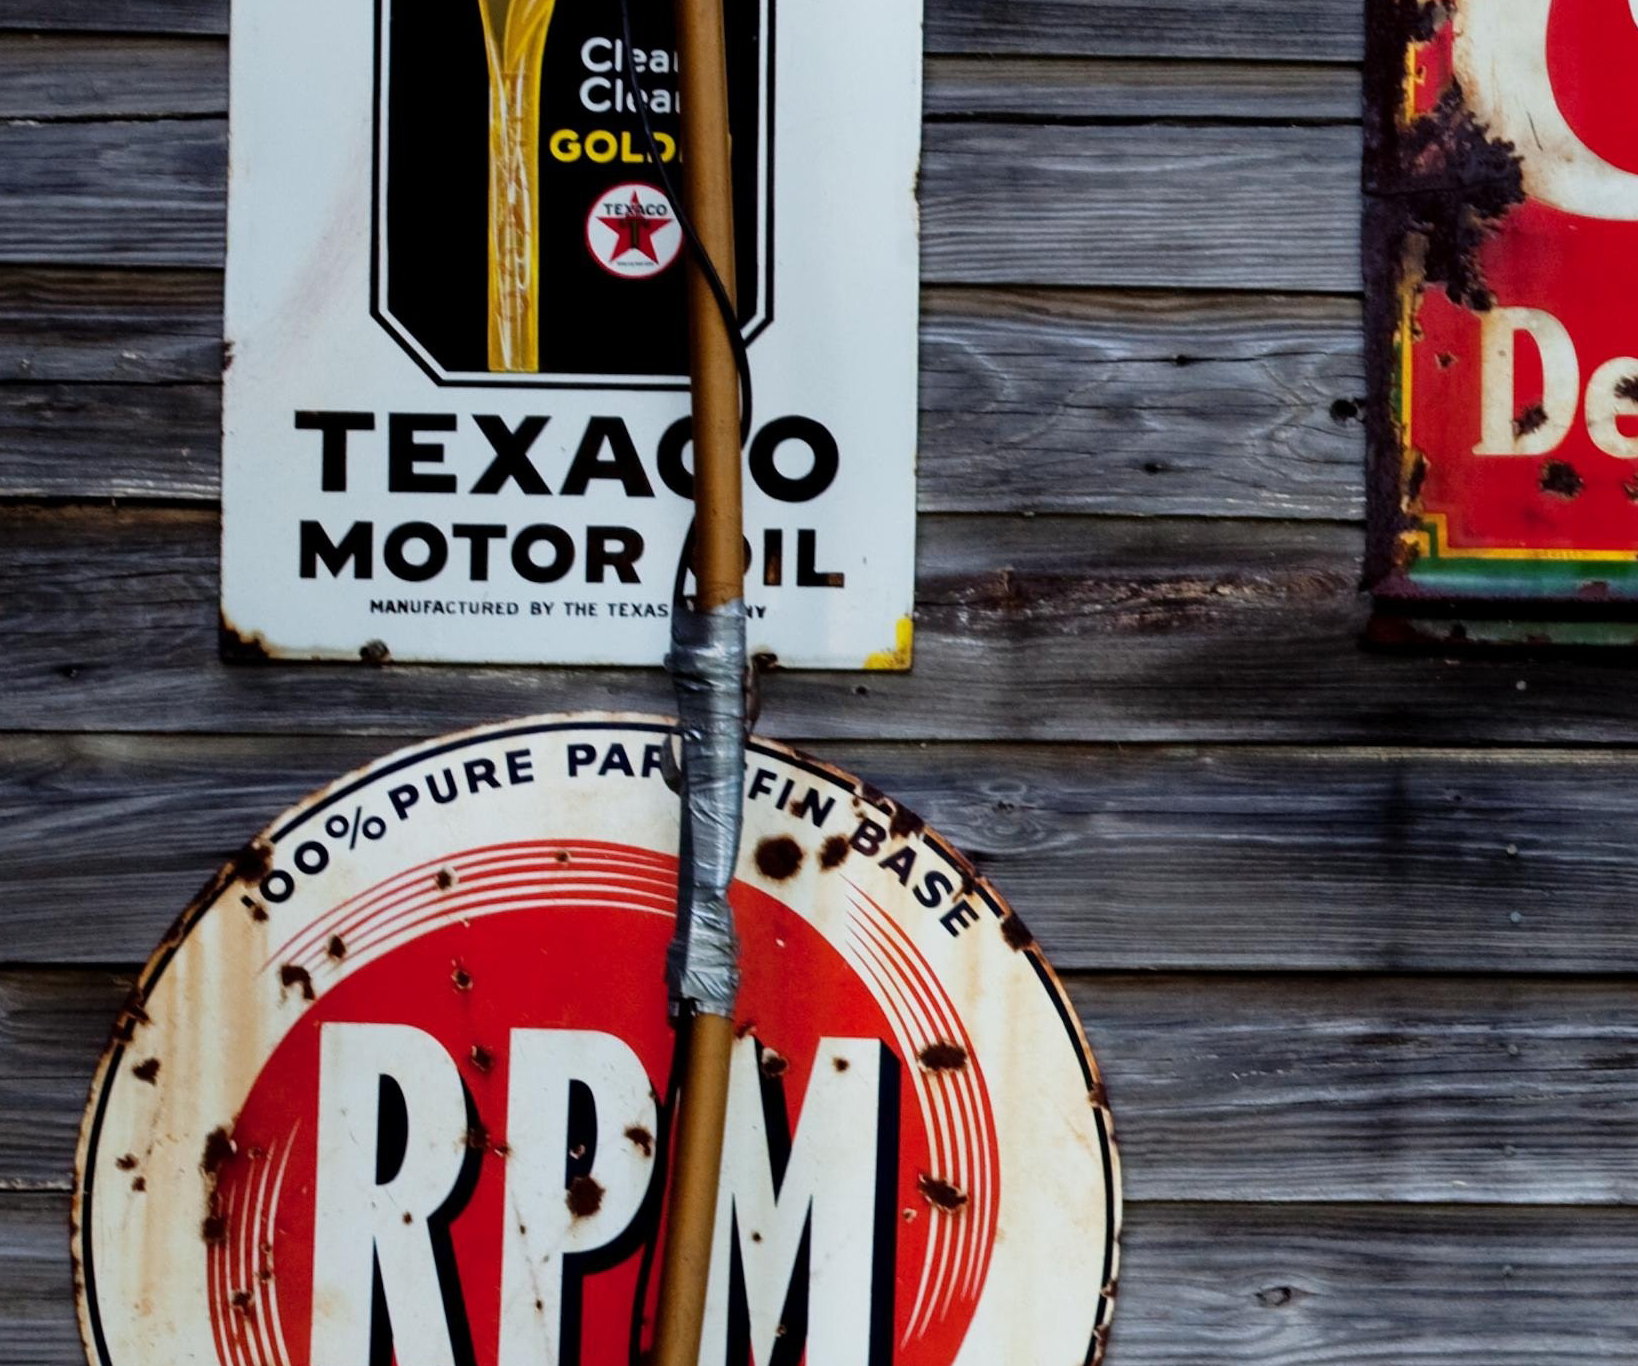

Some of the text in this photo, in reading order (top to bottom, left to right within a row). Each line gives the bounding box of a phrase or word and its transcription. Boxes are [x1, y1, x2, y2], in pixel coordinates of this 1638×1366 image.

[580, 36, 679, 73] Clea
[579, 76, 681, 114] Clea
[602, 202, 668, 216] TEXACO
[299, 520, 846, 590] MOTOR IL
[368, 599, 670, 619] MANUFACTURED BY THE TEXAS
[387, 748, 536, 822] PURE
[567, 742, 836, 828] PARFIN
[848, 818, 981, 939] BASE
